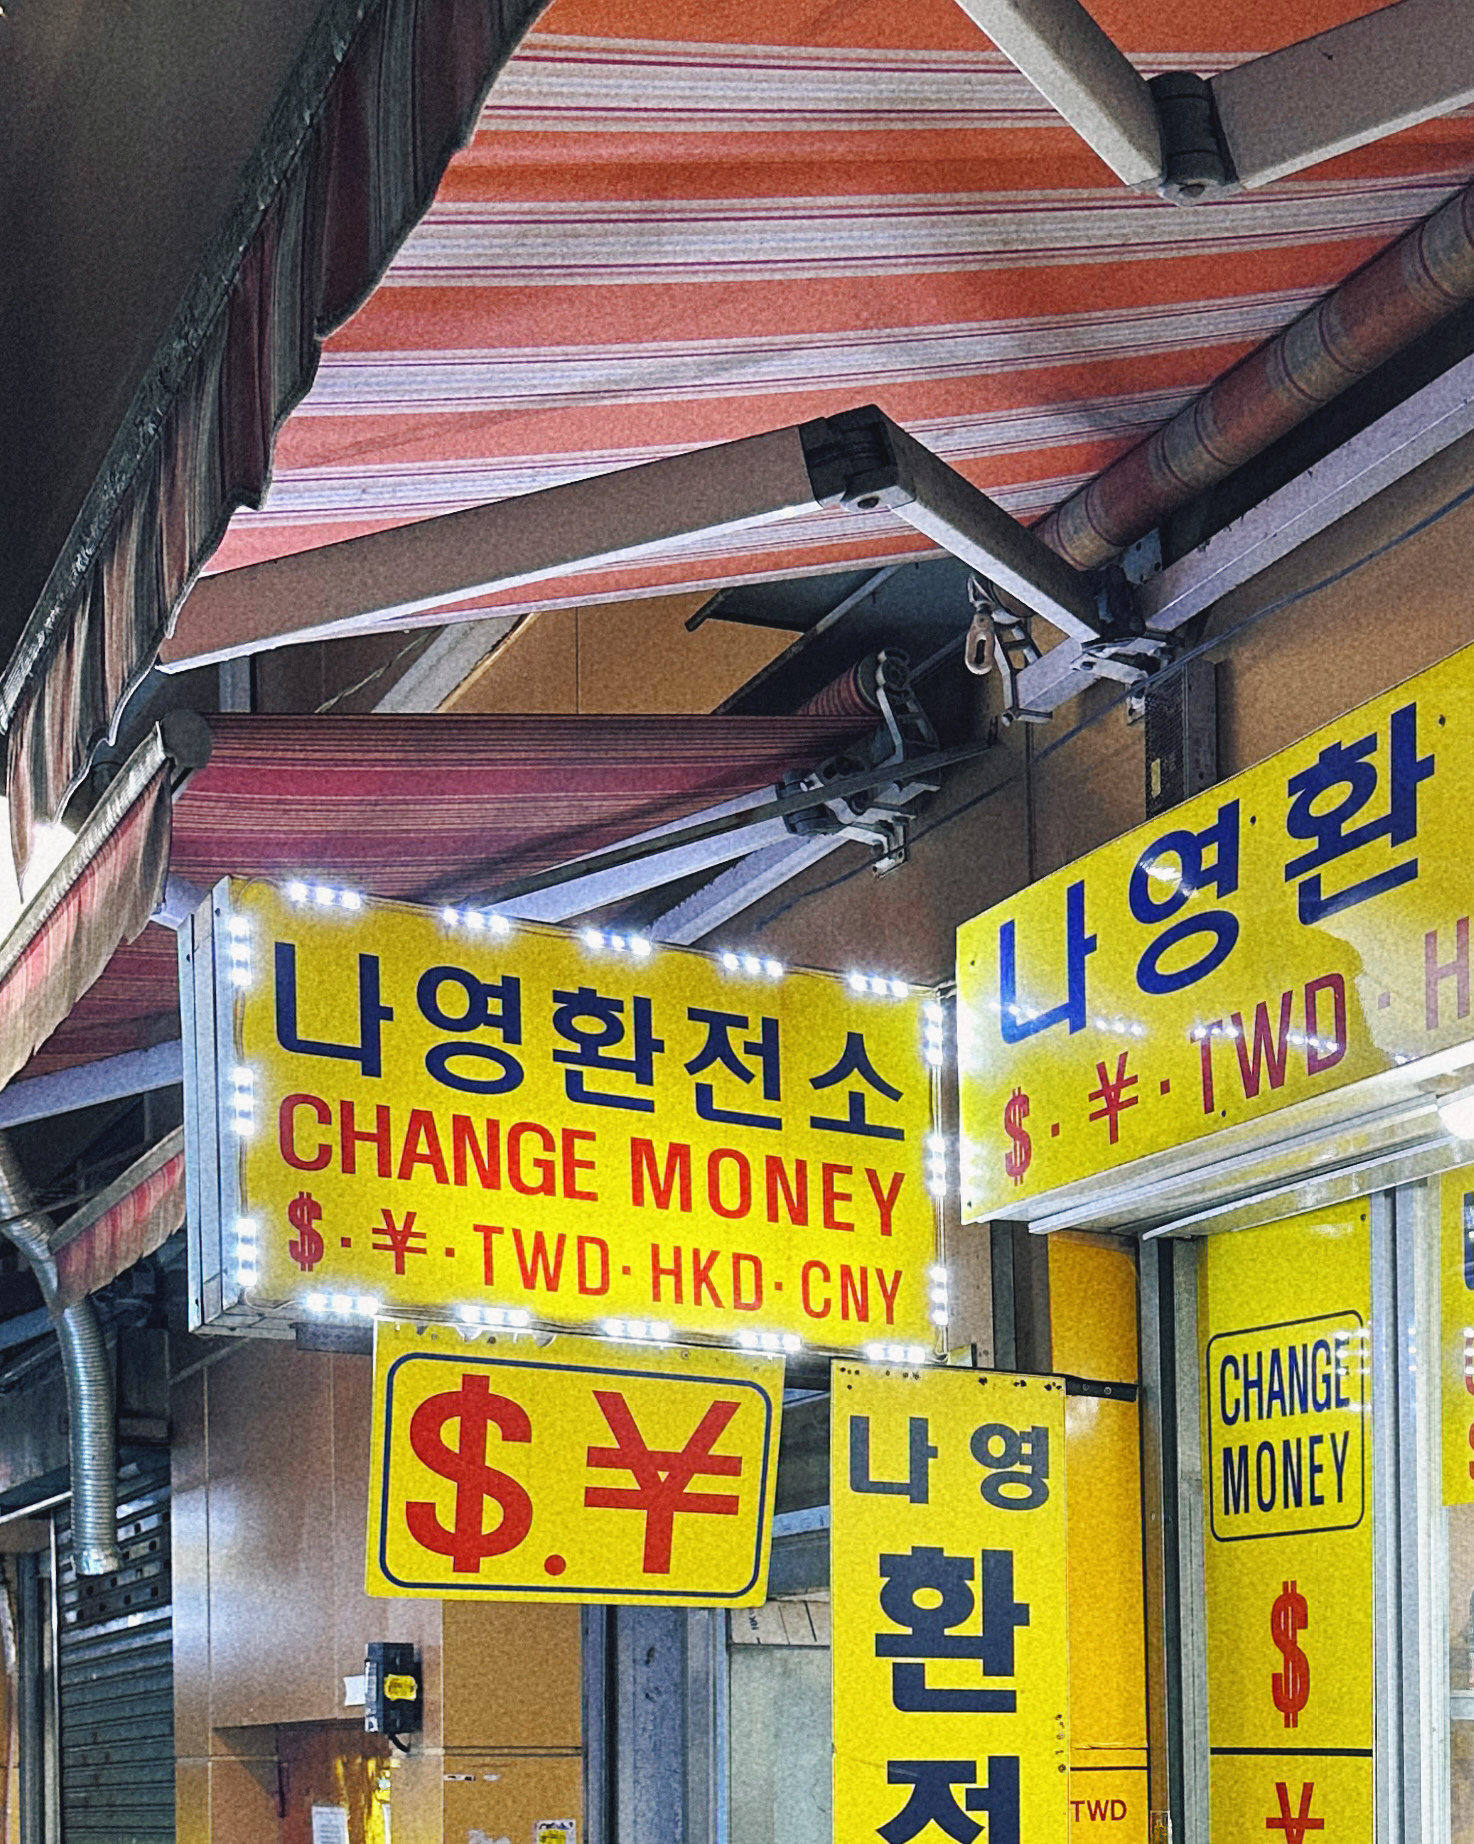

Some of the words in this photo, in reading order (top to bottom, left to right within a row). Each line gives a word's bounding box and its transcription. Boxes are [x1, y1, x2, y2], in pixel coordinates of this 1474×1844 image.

[274, 942, 906, 1141] 나영환전소
[279, 1093, 598, 1200] CHANGE
[631, 1137, 906, 1237] MONEY
[651, 1243, 764, 1312] HKD
[801, 1260, 904, 1326] CNY
[1218, 1336, 1352, 1427] CHANGE
[1221, 1432, 1352, 1513] MONEY
[1268, 1579, 1312, 1730] $
[1070, 1800, 1127, 1822] TWD
